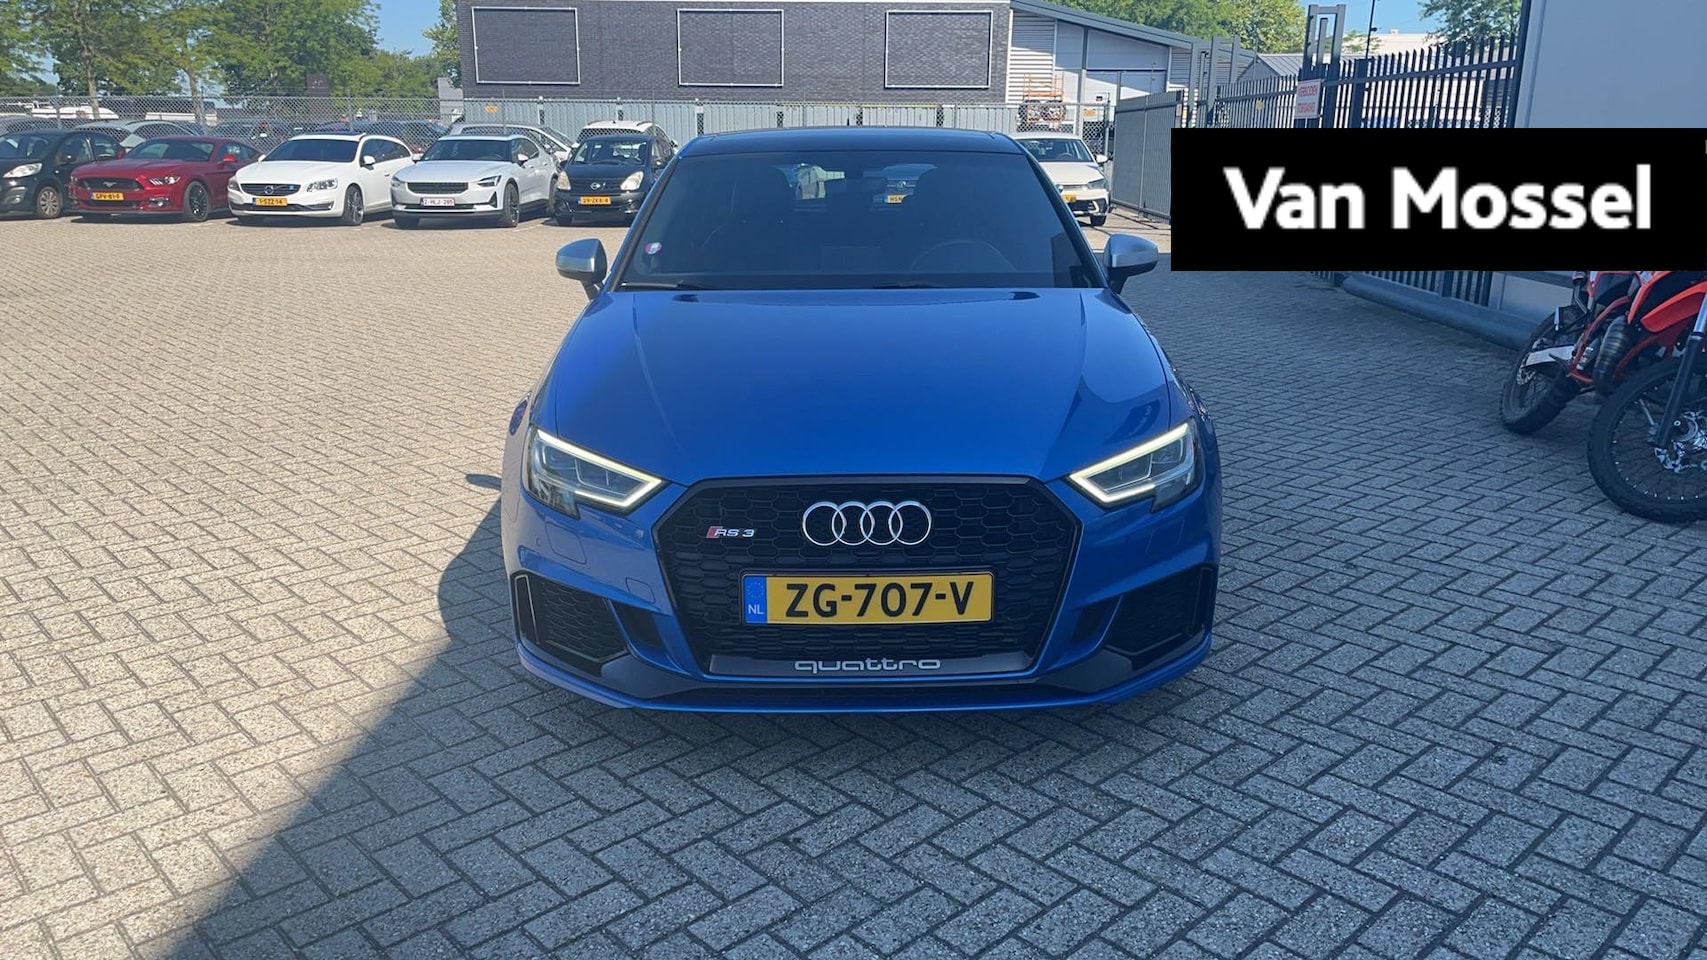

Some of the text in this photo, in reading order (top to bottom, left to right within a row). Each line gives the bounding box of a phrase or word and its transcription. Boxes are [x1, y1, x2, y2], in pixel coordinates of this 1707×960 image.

[785, 581, 975, 618] ZG-707-V
[748, 604, 764, 615] NL
[794, 657, 941, 674] quattro
